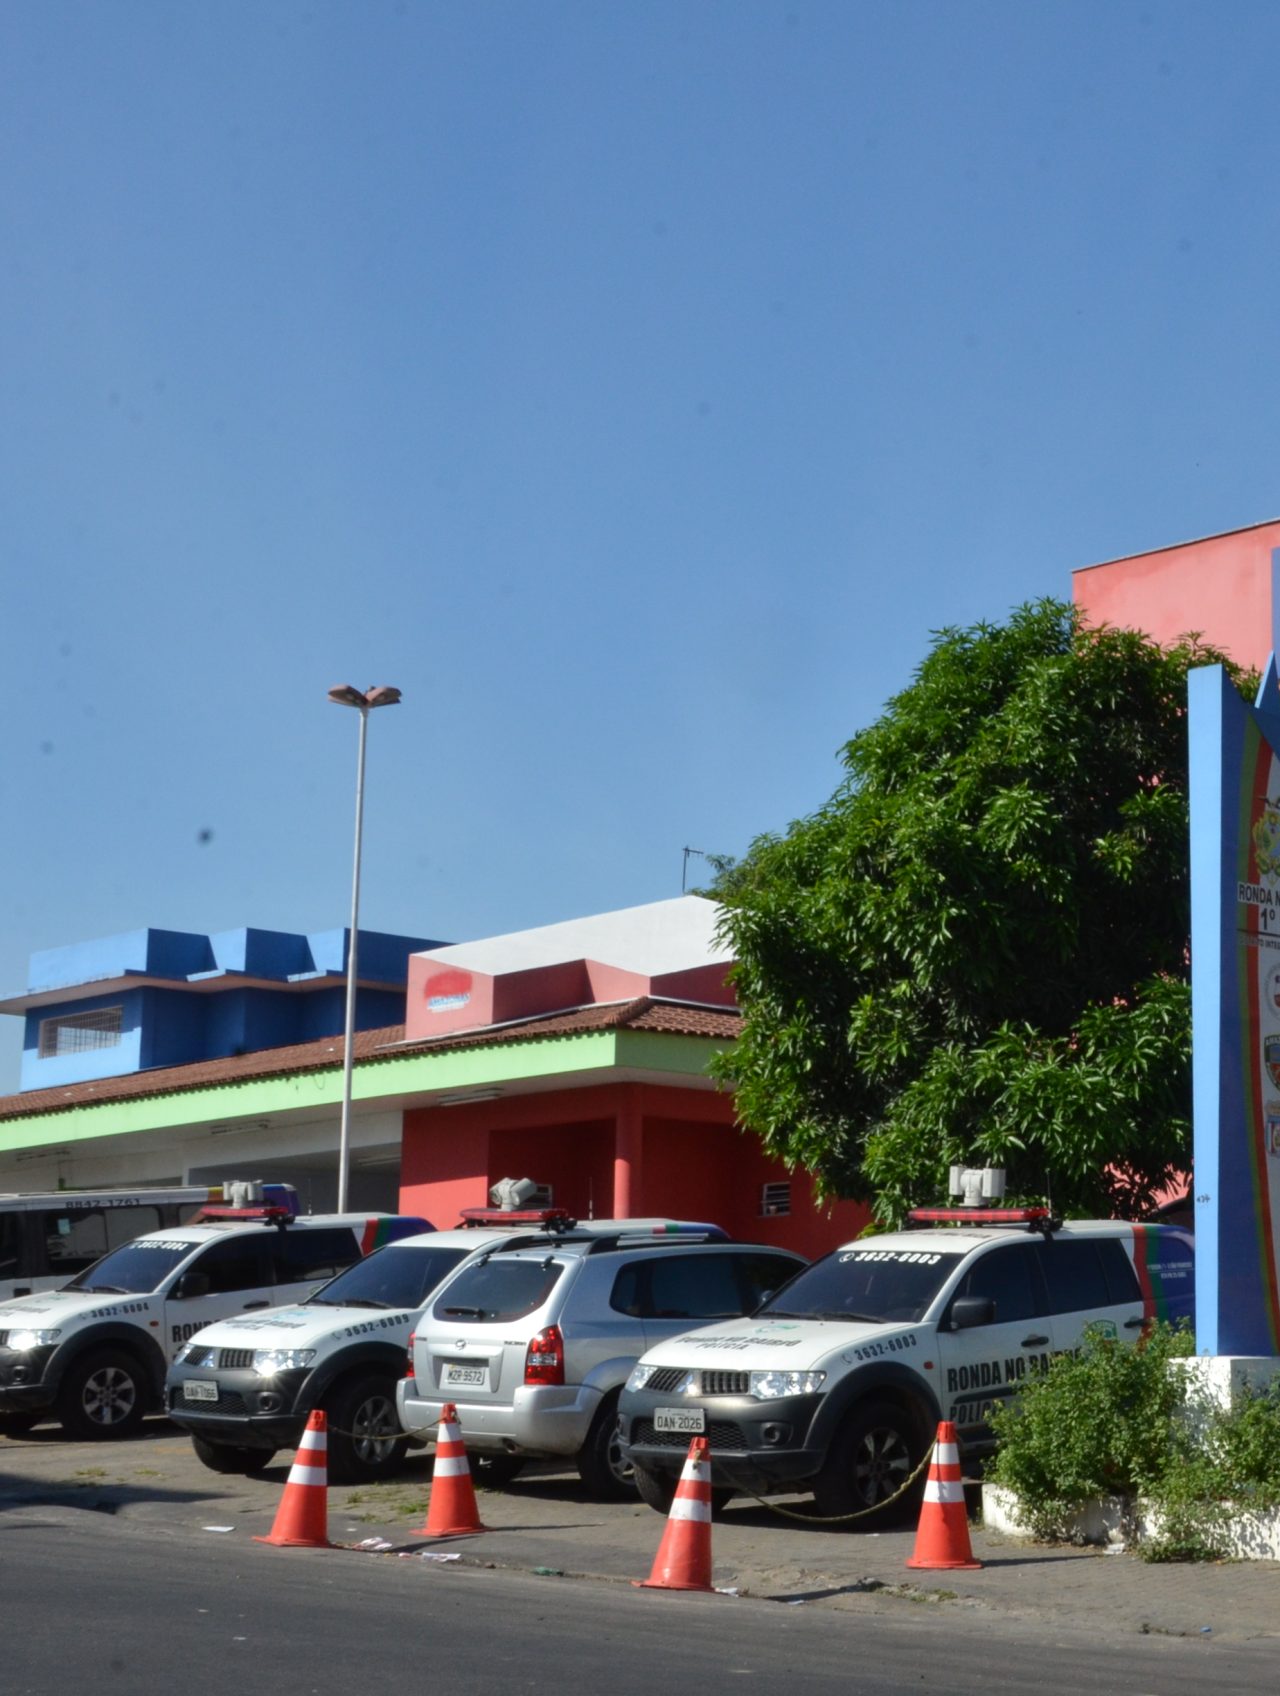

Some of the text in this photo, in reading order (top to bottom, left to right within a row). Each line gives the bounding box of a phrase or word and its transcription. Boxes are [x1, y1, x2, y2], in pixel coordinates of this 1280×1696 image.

[1239, 884, 1273, 906] RONDA
[1261, 907, 1276, 931] 1º
[854, 1252, 941, 1265] 3632-6003
[344, 1313, 410, 1338] 3632-6009
[854, 1334, 917, 1361] 3632-6003
[947, 1360, 1001, 1393] RONDA
[1005, 1357, 1026, 1382] NO
